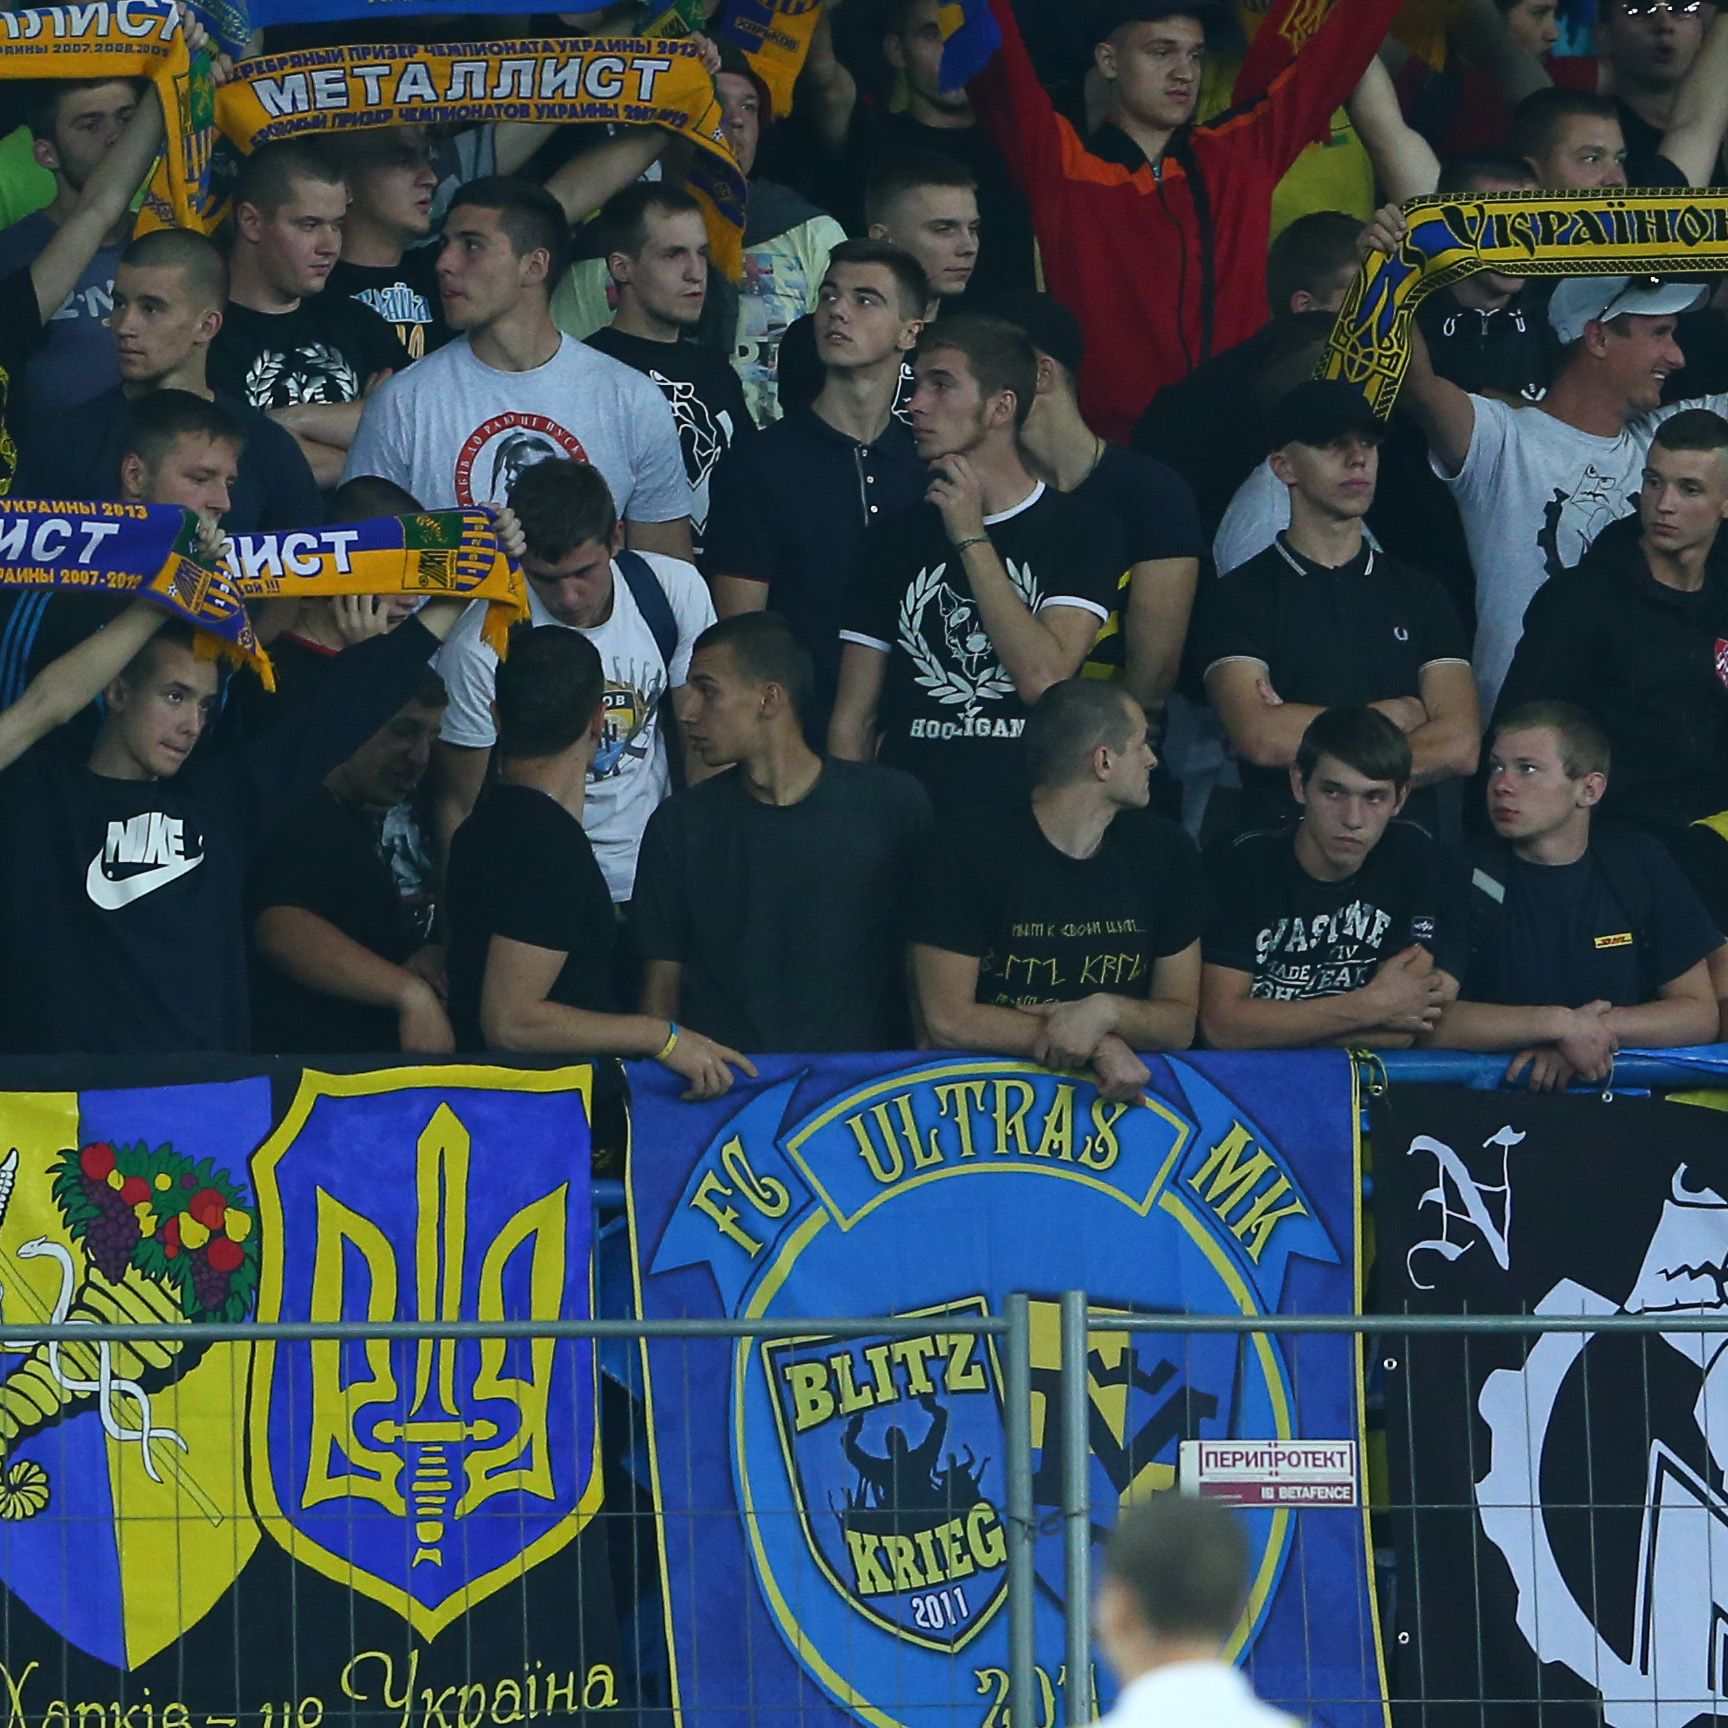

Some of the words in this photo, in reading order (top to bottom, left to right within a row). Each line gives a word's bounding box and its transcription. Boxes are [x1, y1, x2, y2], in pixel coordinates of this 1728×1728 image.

[348, 42, 418, 62] ПРИЗЕР
[552, 38, 651, 55] УКРАИНЫ
[251, 57, 671, 120] МЕТАЛЛИСТ
[0, 500, 96, 515] УКРАИНЫ
[106, 811, 186, 863] NIKE
[847, 1078, 1130, 1184] ULTRAS
[689, 1134, 793, 1260] FC
[1187, 1120, 1310, 1267] MK
[780, 1330, 988, 1432] BLITZ
[1204, 1449, 1348, 1469] ПЕРИПРОТЕКТ
[1279, 1485, 1352, 1500] BETAFENCE
[845, 1500, 1009, 1598] KRIEG
[909, 1585, 971, 1631] 2011
